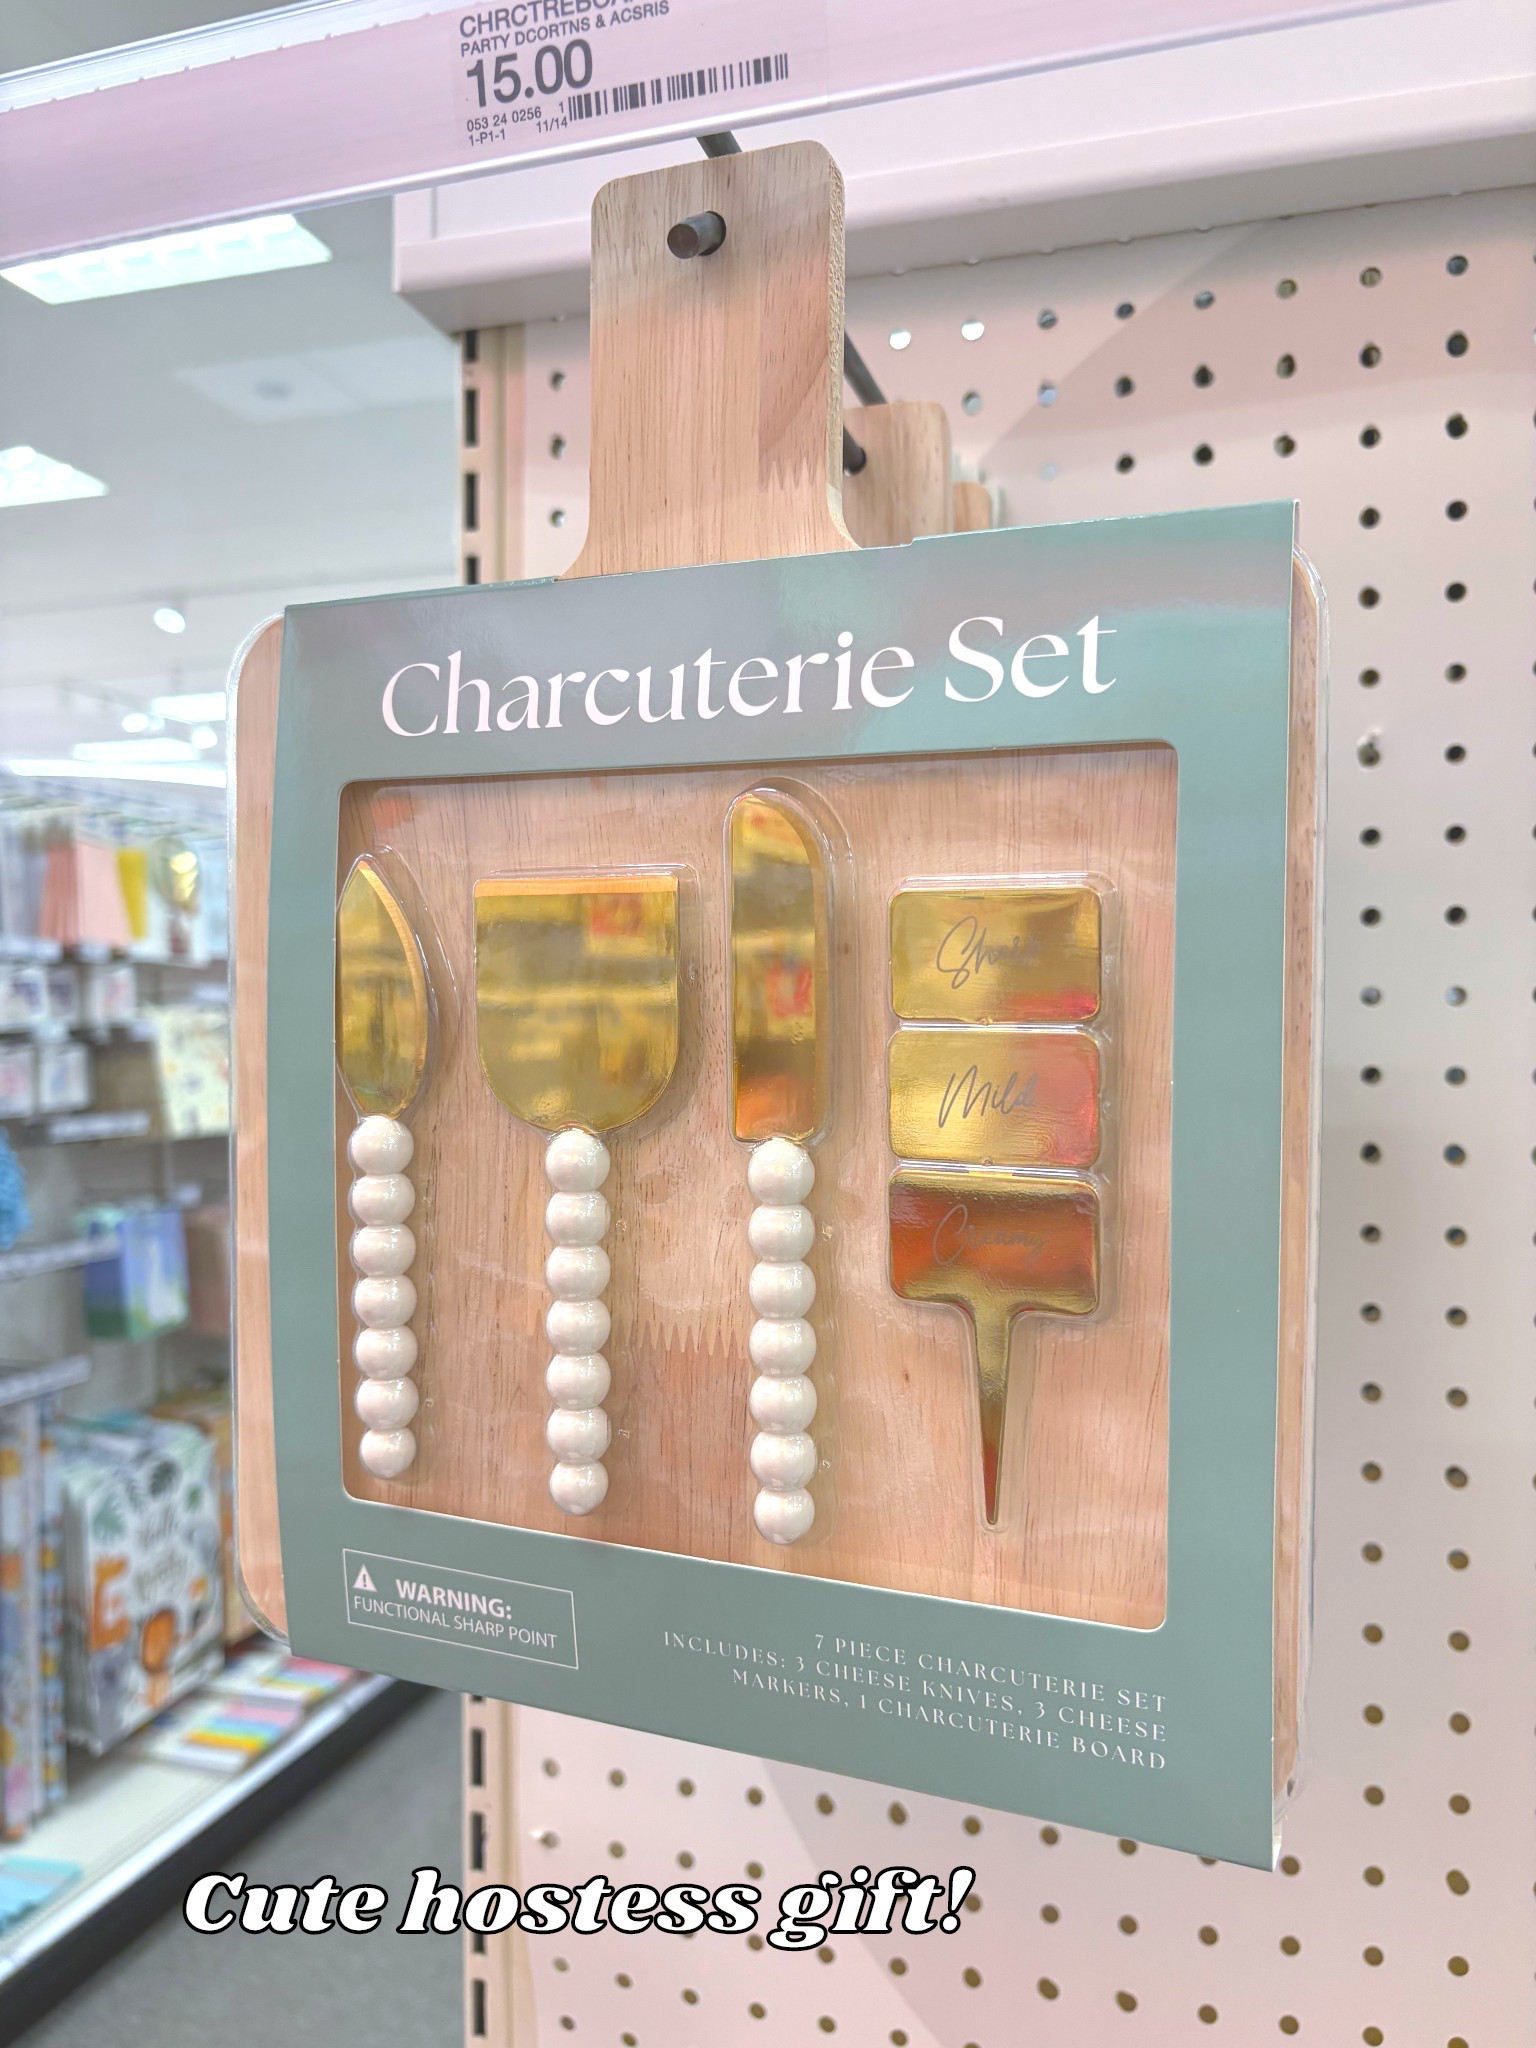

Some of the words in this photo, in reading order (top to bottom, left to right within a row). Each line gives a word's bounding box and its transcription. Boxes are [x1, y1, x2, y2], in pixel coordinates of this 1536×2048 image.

[461, 34, 510, 57] PARTY
[515, 17, 591, 46] DCORTNS
[595, 15, 606, 29] &
[610, 0, 670, 26] ACSRIS
[466, 39, 593, 108] 15.00
[466, 116, 489, 132] 053
[493, 113, 508, 127] 24
[511, 106, 542, 123] 0256
[468, 128, 506, 147] 1-P1-1
[536, 116, 568, 133] 11/14
[381, 630, 915, 737] Charcuterie
[944, 615, 1118, 703] Set
[354, 1596, 450, 1628] FUNCTIONAL
[454, 1615, 504, 1638] SHARP
[509, 1626, 558, 1649] POINT
[395, 1578, 513, 1620] WARNING:
[664, 1631, 785, 1668] INCLUDES:
[796, 1656, 804, 1672] 3
[816, 1660, 911, 1692] CHEESE
[923, 1680, 1023, 1717] KNIVES,
[1034, 1701, 1045, 1719] 3
[1058, 1706, 1166, 1742] CHEESE
[815, 1634, 824, 1649] 7
[835, 1637, 906, 1665] PIECE
[918, 1653, 1104, 1702] CHARCUTERIE
[1117, 1688, 1166, 1713] SET
[732, 1668, 849, 1708] MARKERS,
[861, 1694, 866, 1709] 1
[878, 1698, 1060, 1749] CHARCUTERIE
[1072, 1736, 1166, 1770] BOARD
